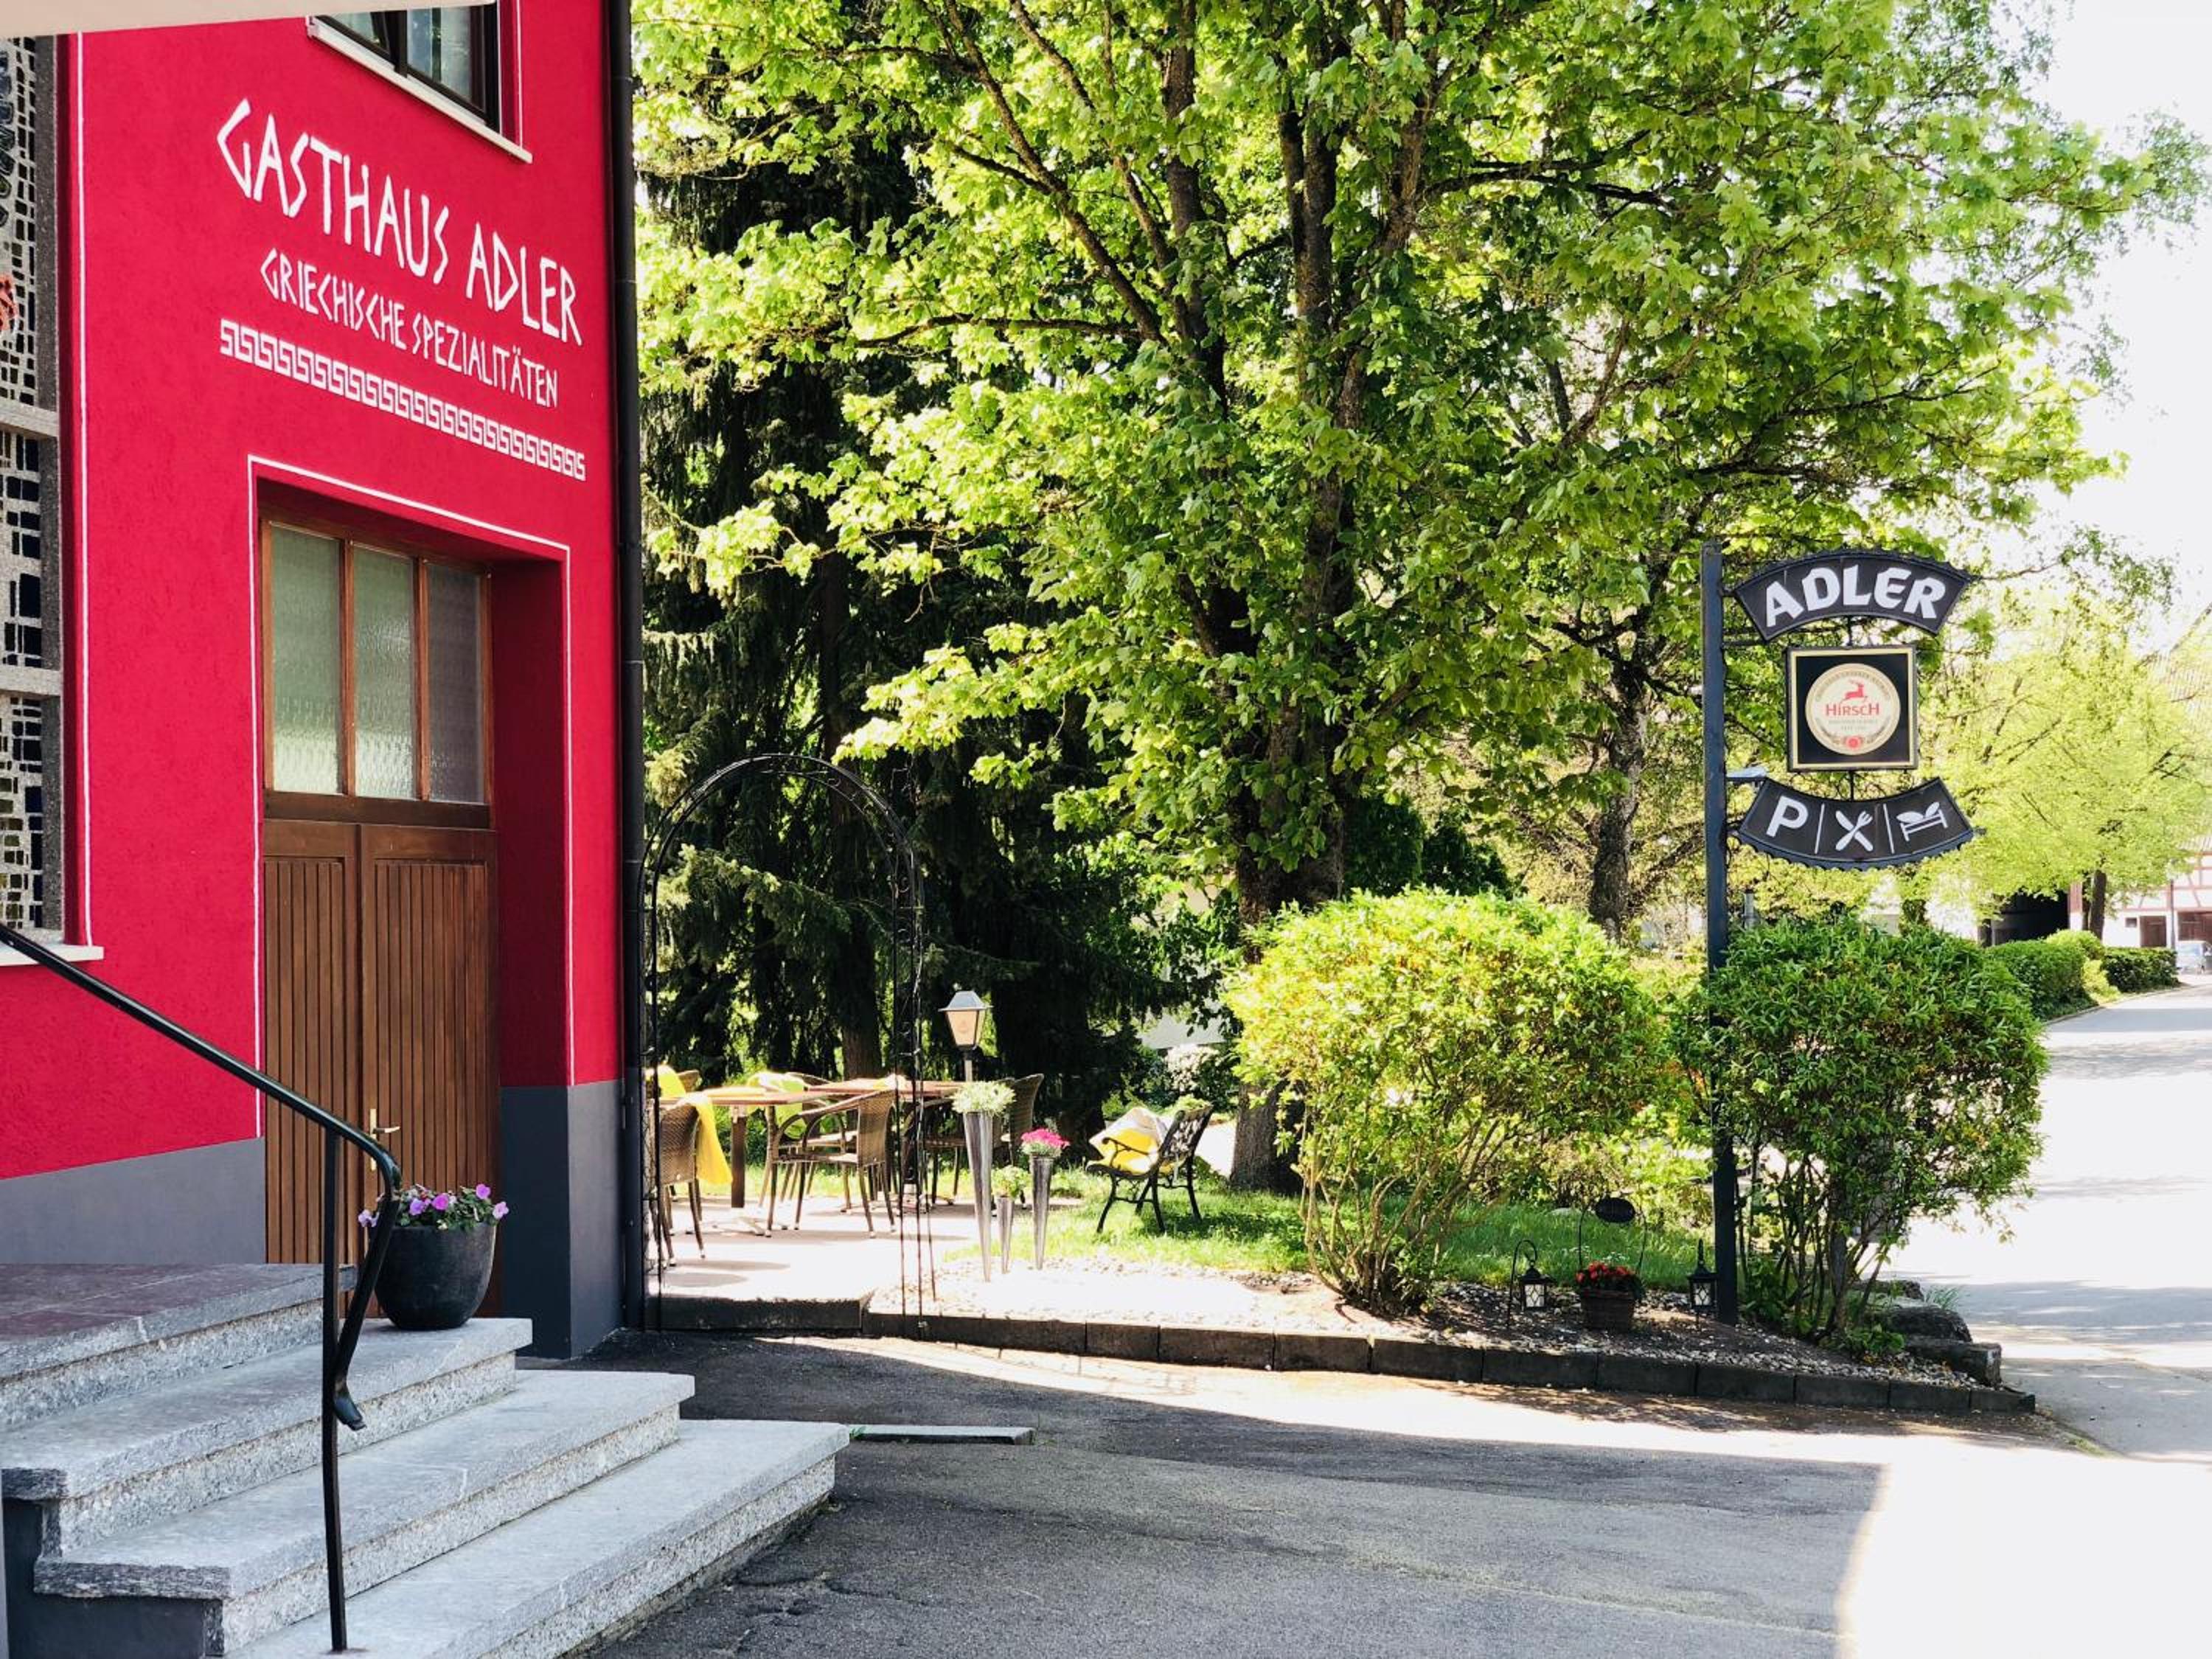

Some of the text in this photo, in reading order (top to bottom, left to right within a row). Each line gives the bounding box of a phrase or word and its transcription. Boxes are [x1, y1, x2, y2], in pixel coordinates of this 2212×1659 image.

[217, 98, 582, 346] GASTHAUS ADLER
[260, 248, 558, 408] GRIECHISCHE SPEZIALITÄTEN
[1766, 564, 1946, 627] ADLER
[1766, 796, 1809, 838] P
